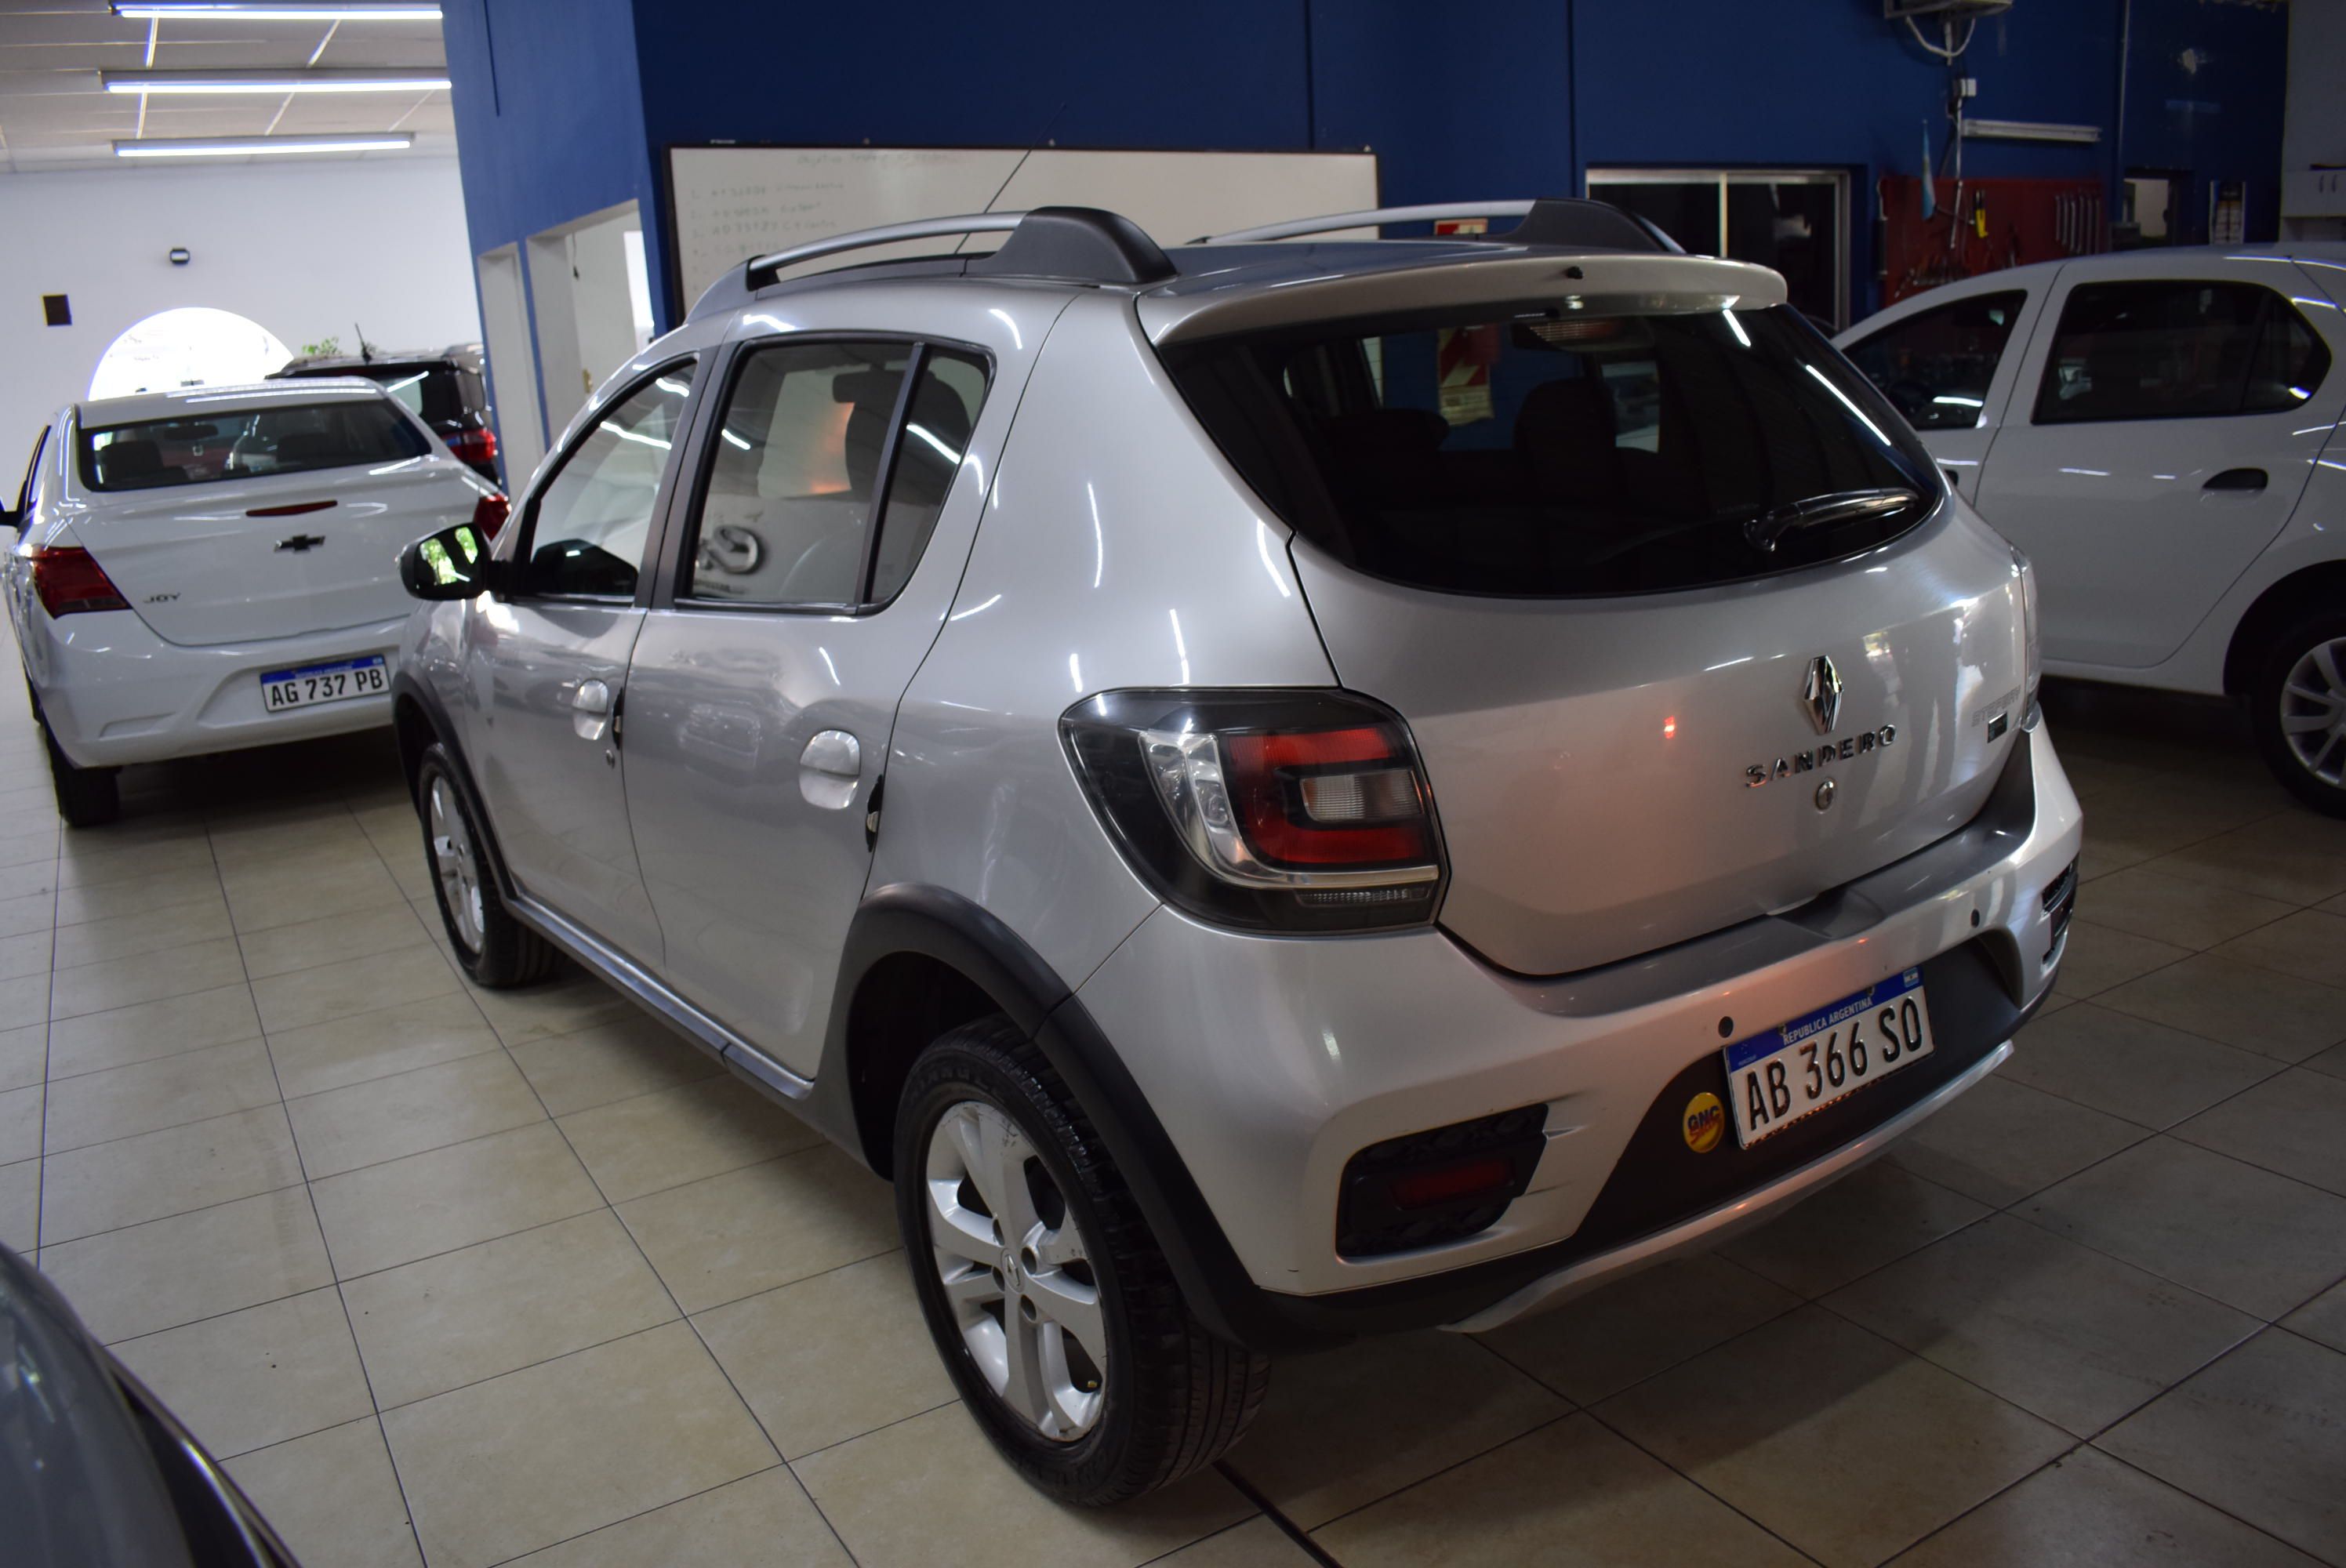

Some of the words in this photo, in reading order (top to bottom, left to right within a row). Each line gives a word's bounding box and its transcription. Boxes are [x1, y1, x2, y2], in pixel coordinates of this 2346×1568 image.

[143, 592, 181, 604] JOY
[271, 682, 300, 706] AG
[305, 673, 346, 700] 737
[354, 668, 383, 692] PB
[1745, 724, 1898, 788] SANDERO
[1782, 1017, 1828, 1045] REPUBLICA
[1828, 996, 1873, 1024] ARGENTINA
[1747, 1058, 1791, 1131] AB
[1799, 1020, 1868, 1099] 366
[1879, 996, 1922, 1063] SO
